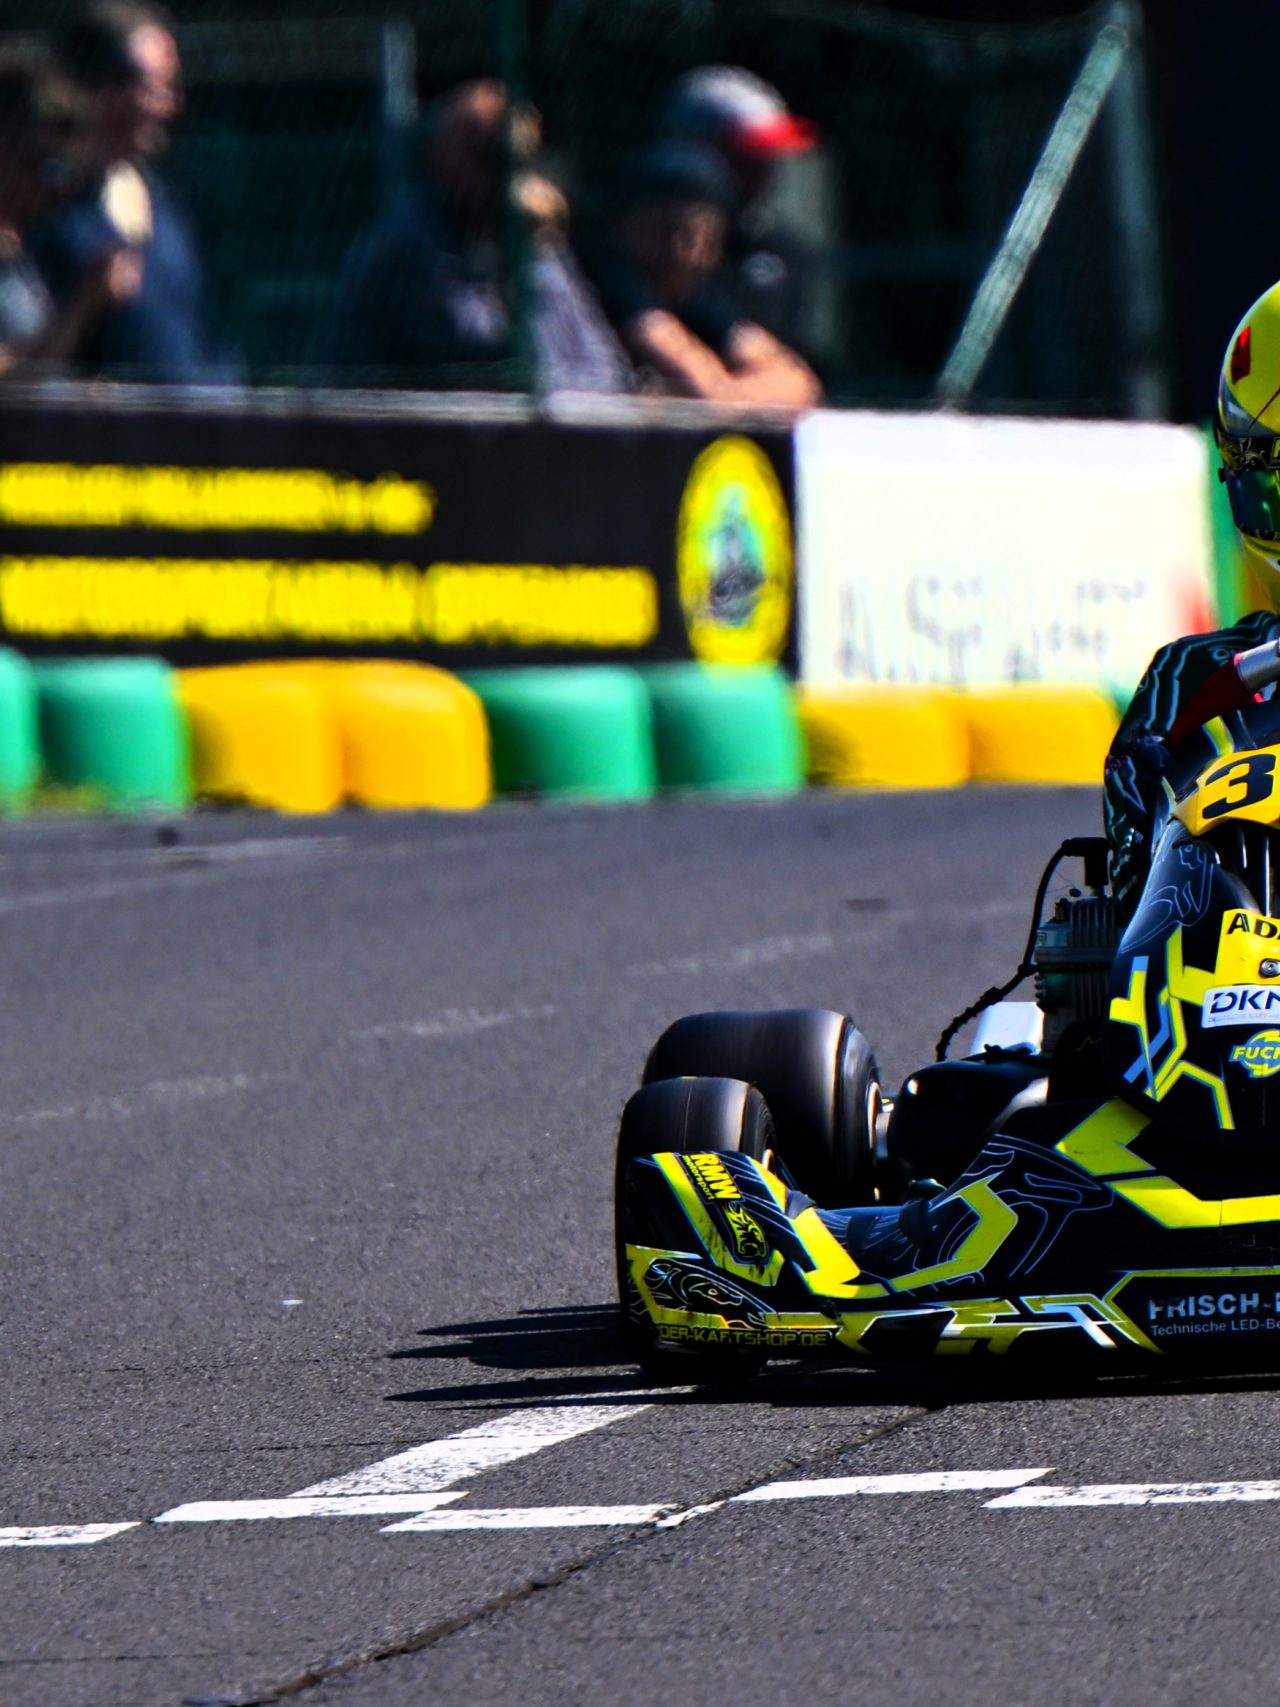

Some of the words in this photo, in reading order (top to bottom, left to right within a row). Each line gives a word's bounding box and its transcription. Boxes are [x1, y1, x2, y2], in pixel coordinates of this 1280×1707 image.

[682, 1154, 716, 1200] motorsport
[689, 1153, 742, 1200] RMW
[1150, 1320, 1227, 1337] Technische
